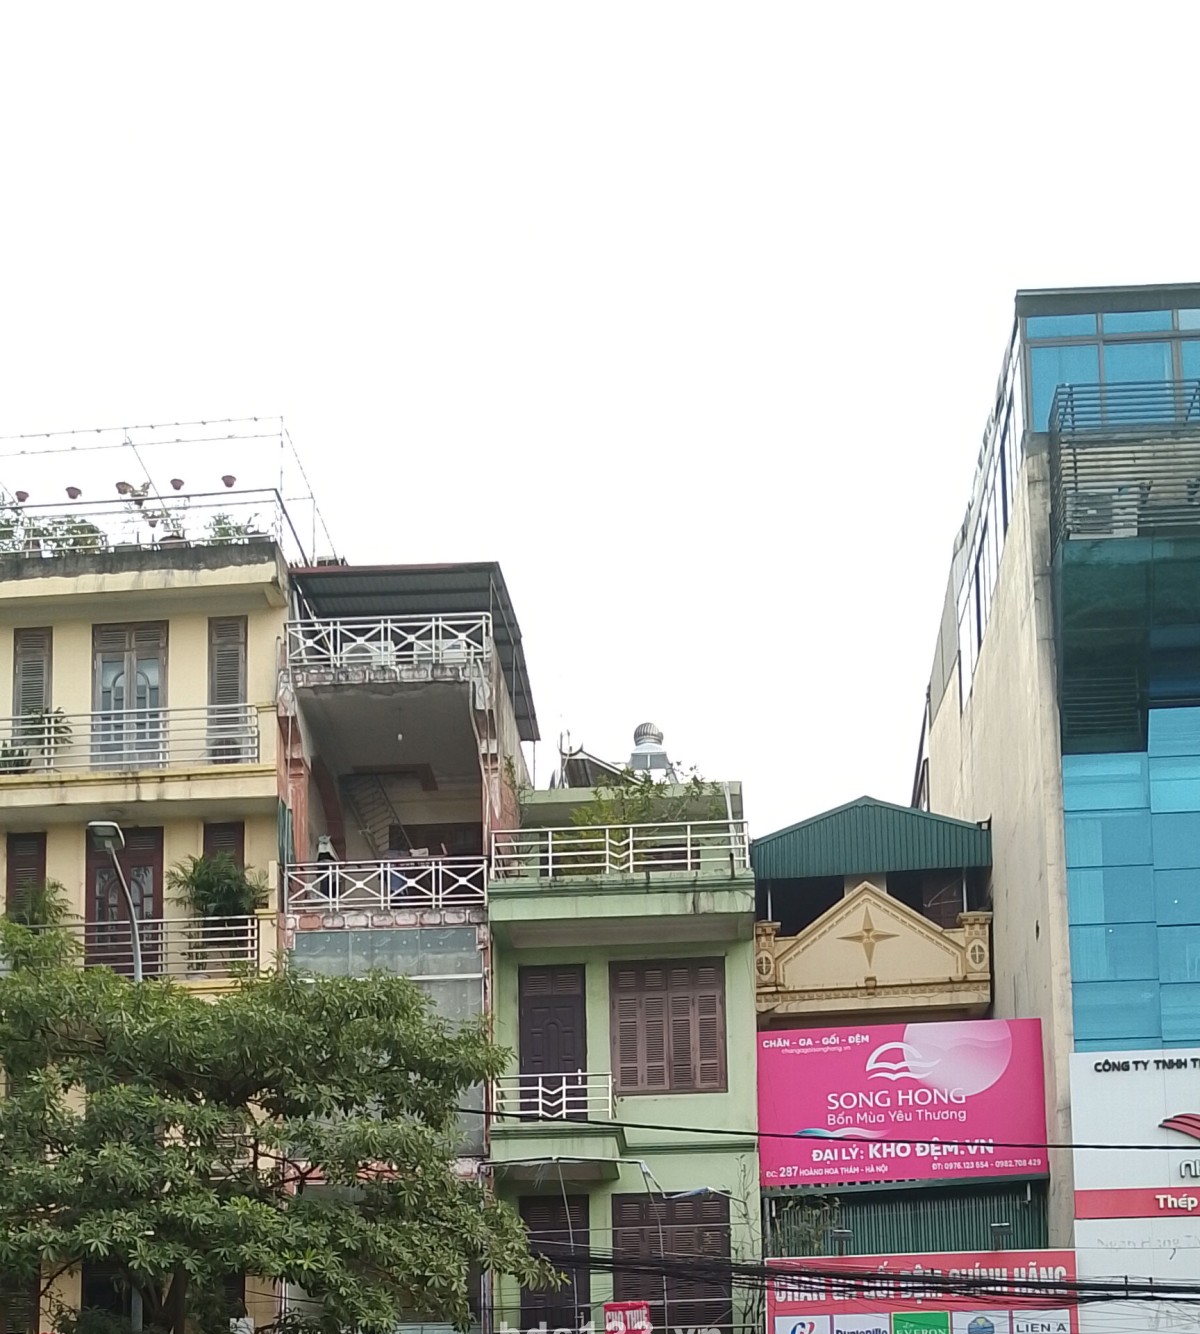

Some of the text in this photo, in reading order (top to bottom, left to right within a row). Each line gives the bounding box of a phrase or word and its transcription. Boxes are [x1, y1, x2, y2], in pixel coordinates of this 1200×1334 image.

[763, 1033, 869, 1048] CHĂN GA GỐI ĐỆM
[1094, 1057, 1200, 1073] CÔNG TY TNHH T
[826, 1087, 966, 1110] SONG HONG
[827, 1109, 967, 1126] Bốn Mùa Yêu Thương
[811, 1148, 838, 1165] ĐẠI
[841, 1144, 864, 1160] LÝ:
[868, 1141, 911, 1159] KHO
[779, 1165, 799, 1178] 287
[1155, 1193, 1198, 1212] Thép
